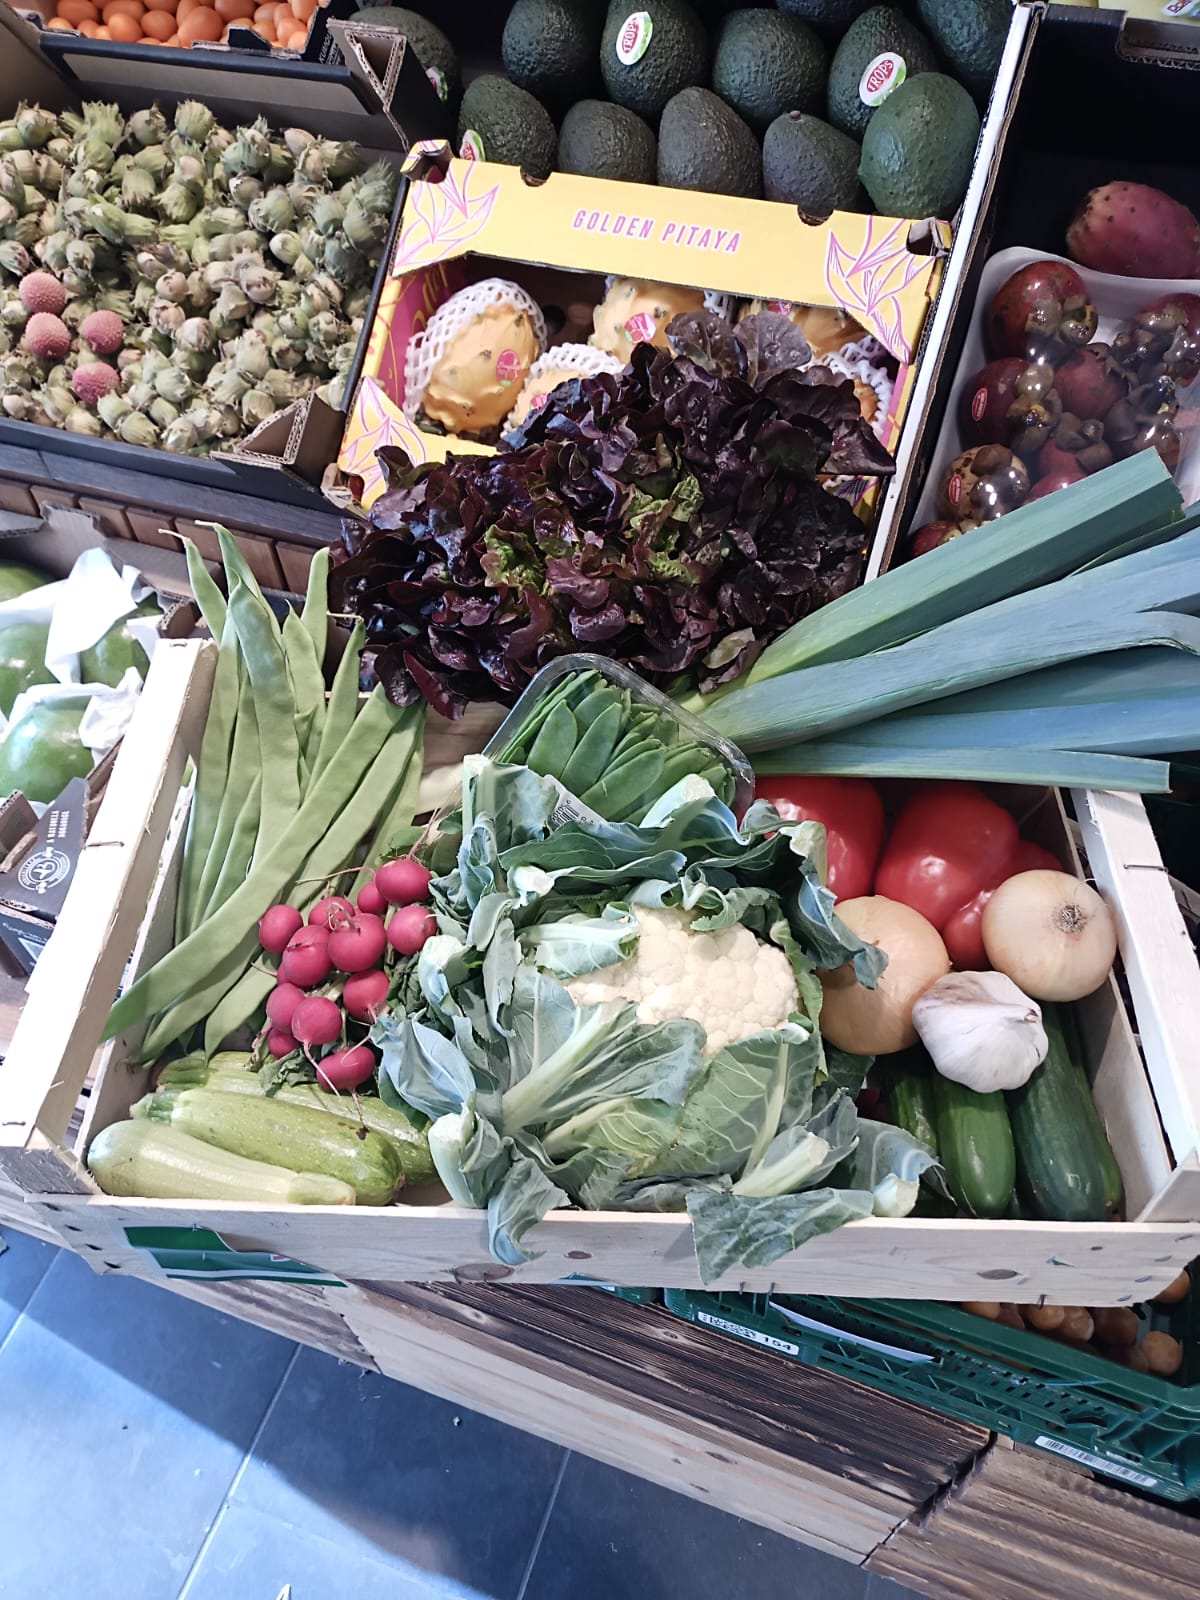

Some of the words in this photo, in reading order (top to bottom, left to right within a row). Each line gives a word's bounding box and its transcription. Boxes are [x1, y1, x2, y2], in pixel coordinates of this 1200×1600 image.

[622, 17, 638, 51] TROPS
[867, 60, 893, 91] TROPS
[572, 209, 654, 239] GOLDEN
[661, 222, 741, 252] PITAYA
